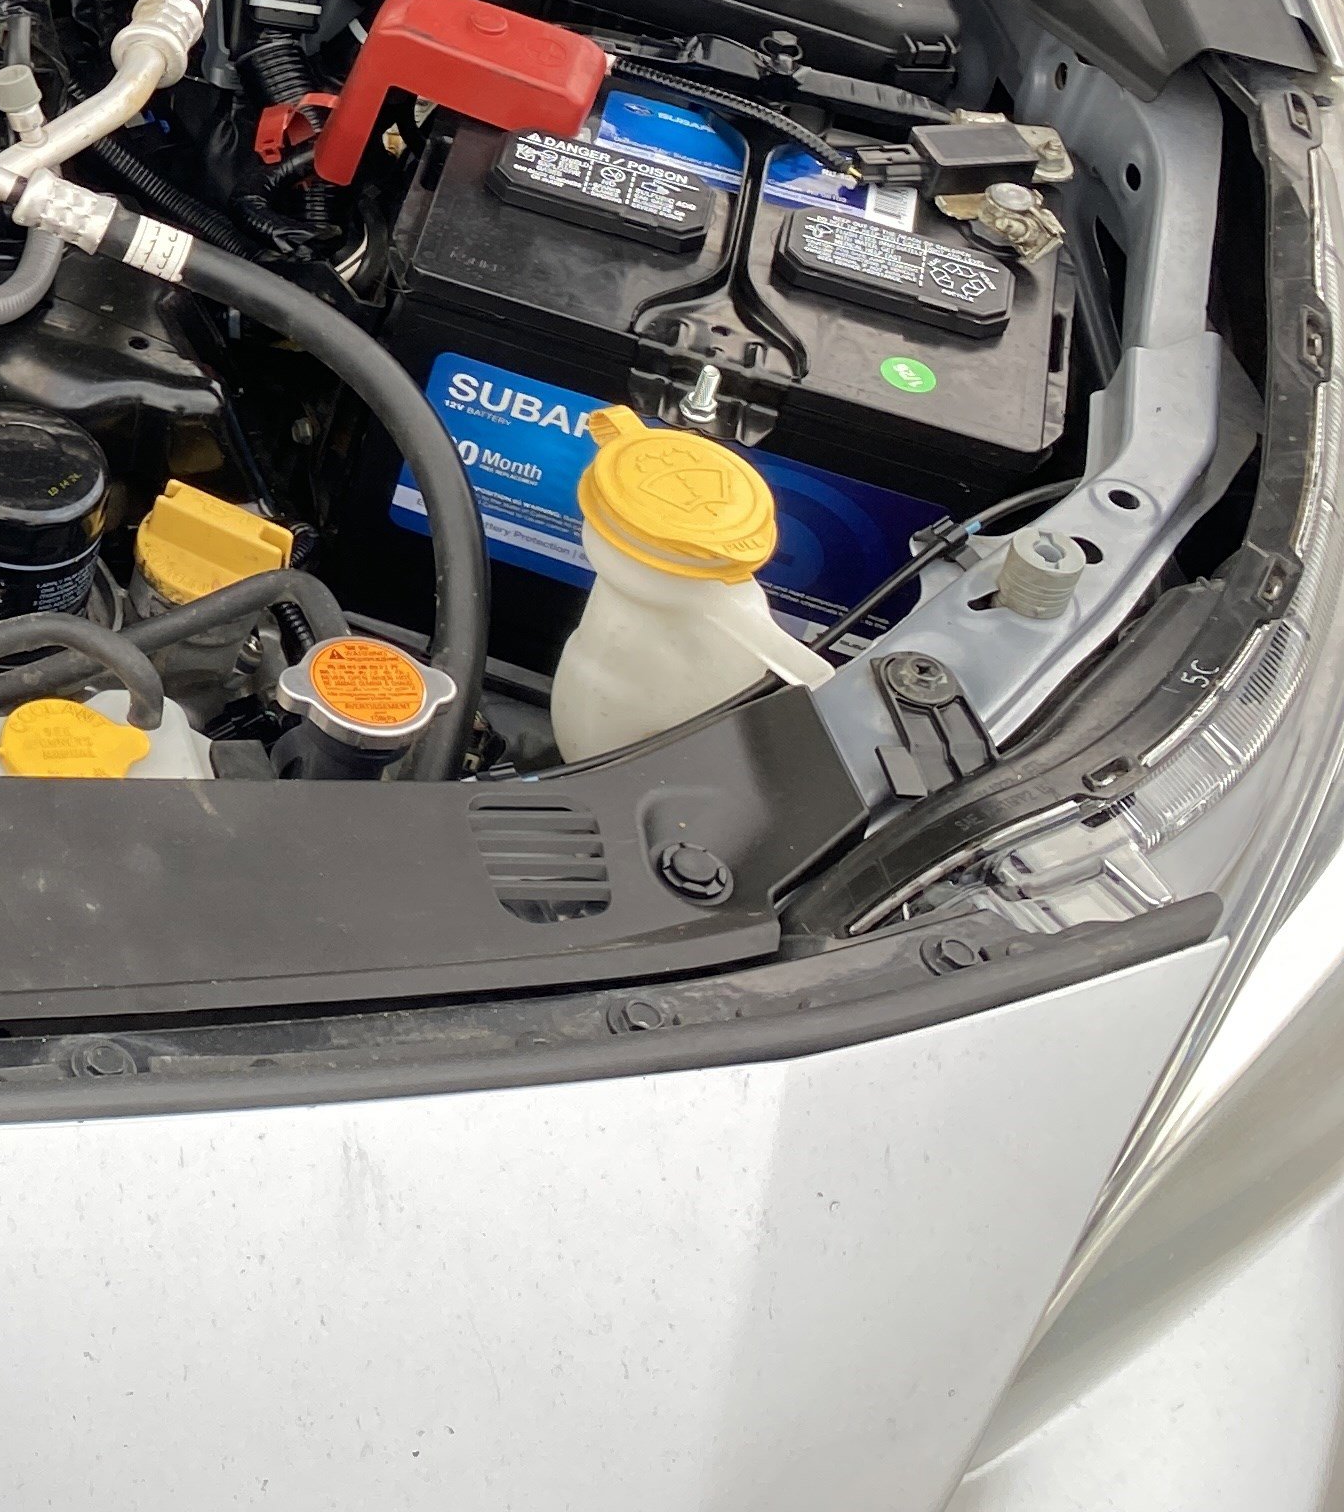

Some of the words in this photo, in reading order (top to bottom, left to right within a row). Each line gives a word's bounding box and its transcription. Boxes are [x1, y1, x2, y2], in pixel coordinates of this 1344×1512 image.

[657, 112, 716, 134] SUBAR
[543, 136, 611, 162] DANGER
[626, 160, 689, 184] POISON
[444, 399, 465, 412] 12V
[466, 406, 512, 426] BATTERY
[448, 373, 593, 438] SUBAR
[481, 448, 543, 481] Month
[513, 530, 569, 554] Protection
[10, 702, 107, 733] COOLANT
